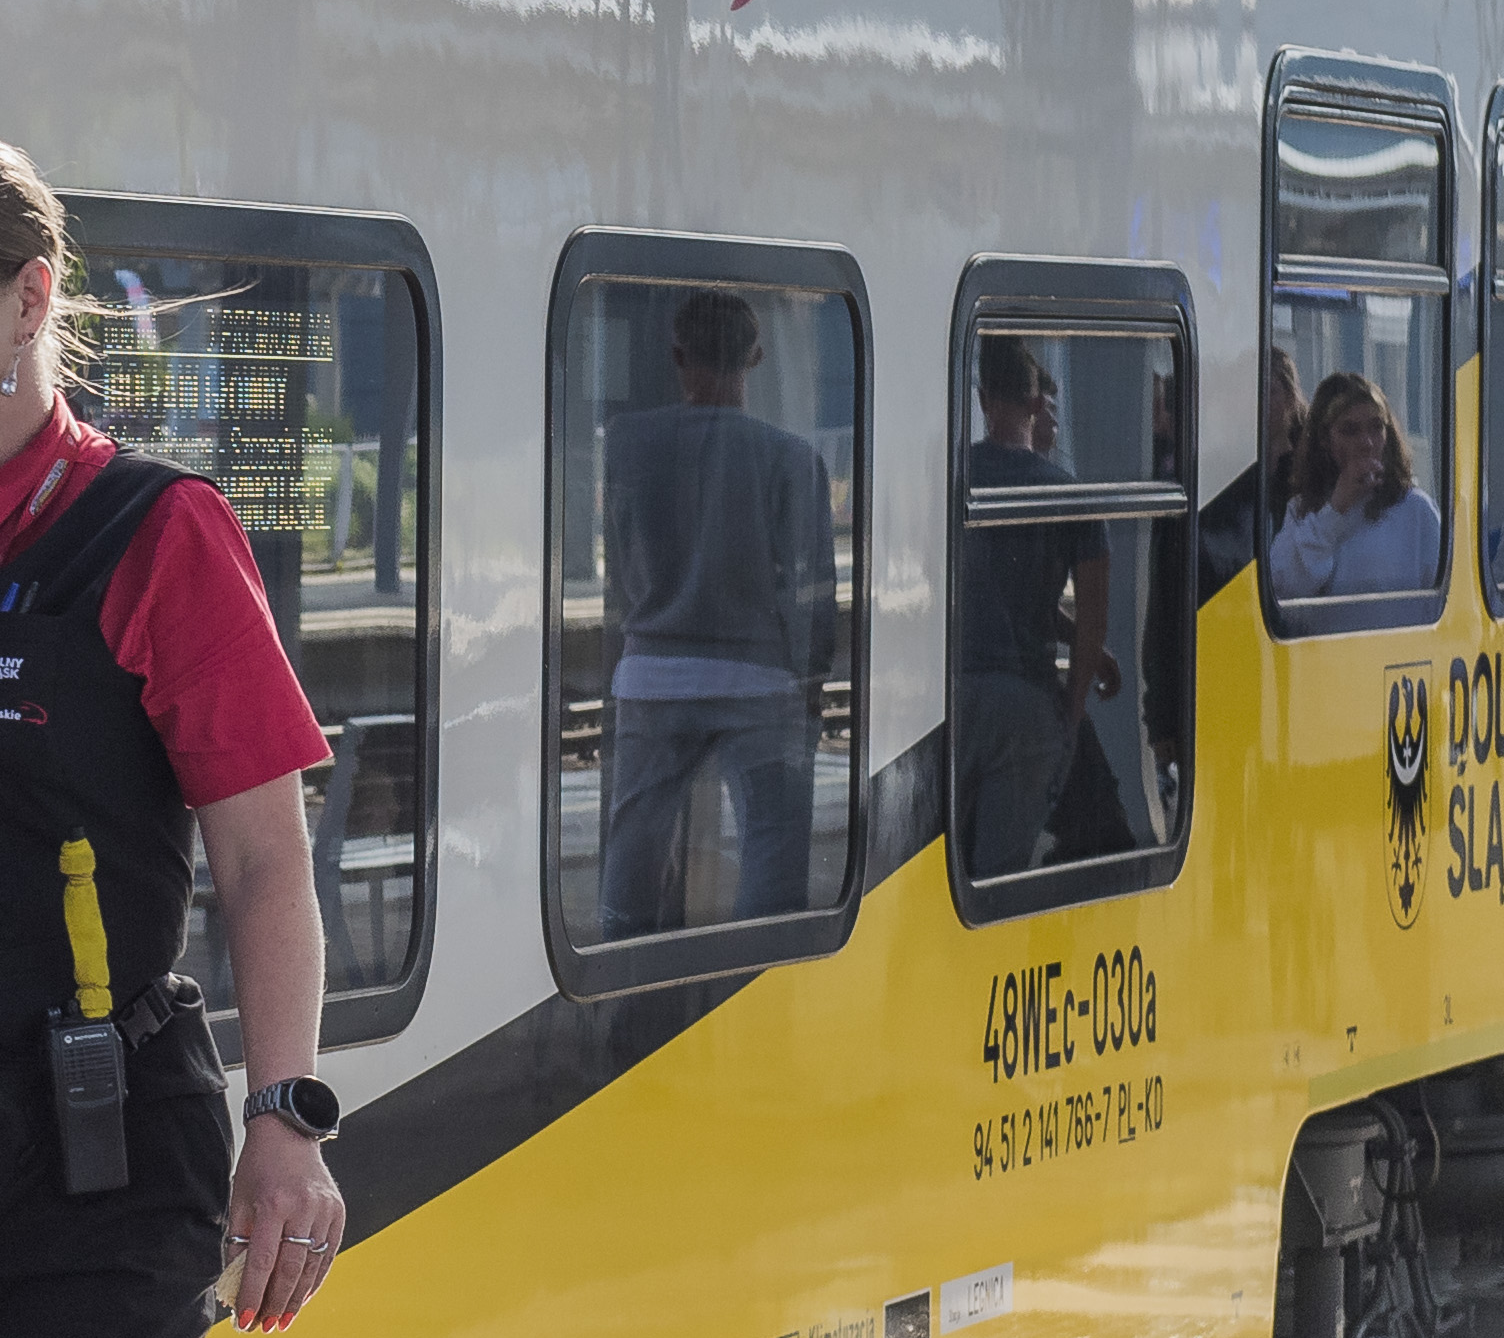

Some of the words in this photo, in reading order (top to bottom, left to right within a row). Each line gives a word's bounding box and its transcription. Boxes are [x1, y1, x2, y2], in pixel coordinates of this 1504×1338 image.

[983, 945, 1157, 1084] 48WEc-030a
[973, 1119, 994, 1181] 94
[1000, 1112, 1017, 1173] 51
[1023, 1108, 1033, 1167] 2
[1038, 1100, 1060, 1162] 141
[1065, 1085, 1113, 1154] 766-7
